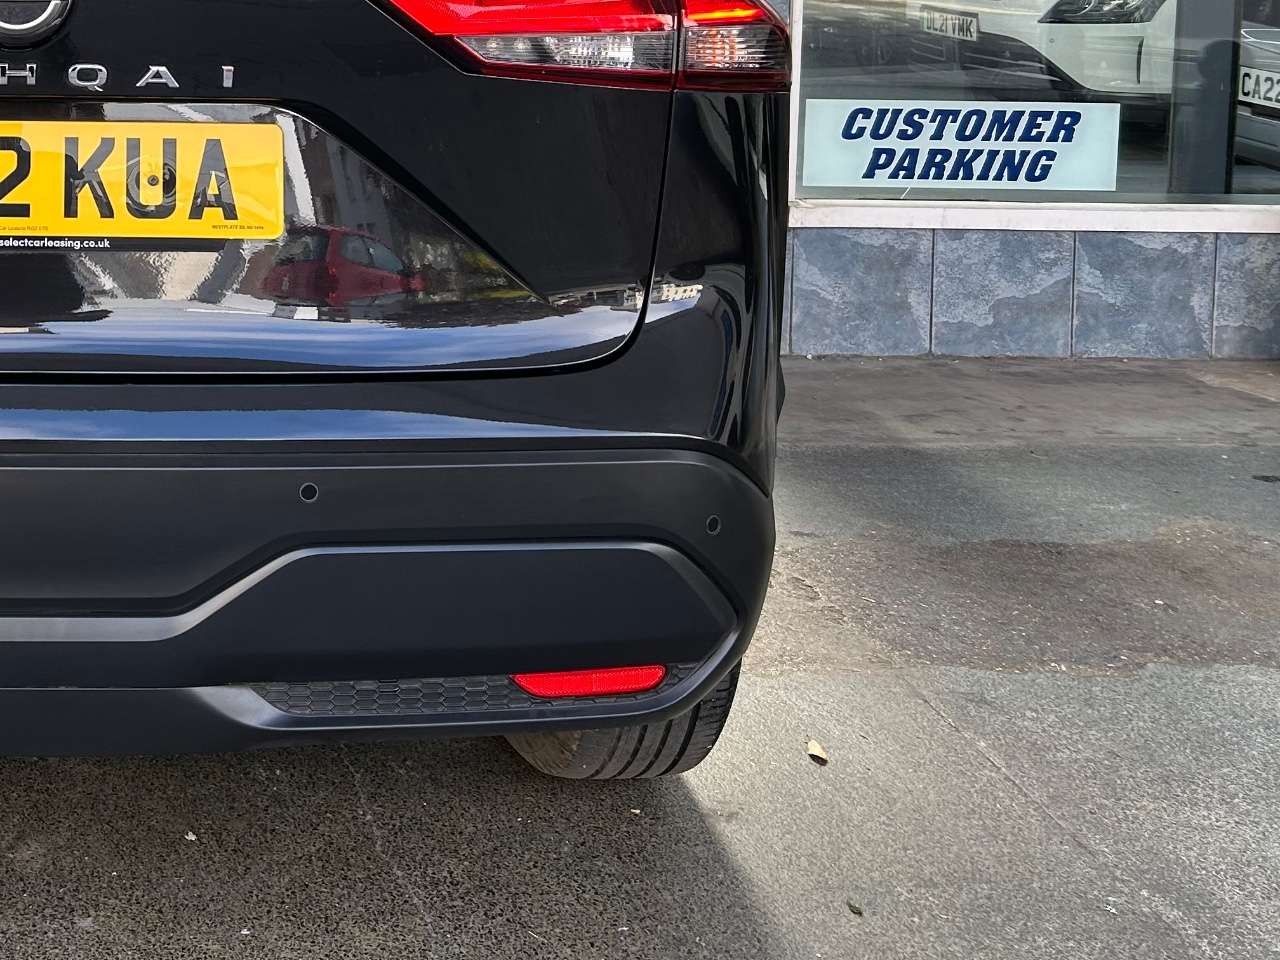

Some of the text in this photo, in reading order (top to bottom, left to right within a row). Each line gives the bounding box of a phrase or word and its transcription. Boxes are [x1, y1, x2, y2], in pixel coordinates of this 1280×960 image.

[841, 107, 1082, 143] CUSTOMER
[63, 136, 238, 221] KUA
[861, 147, 1058, 183] PARKING
